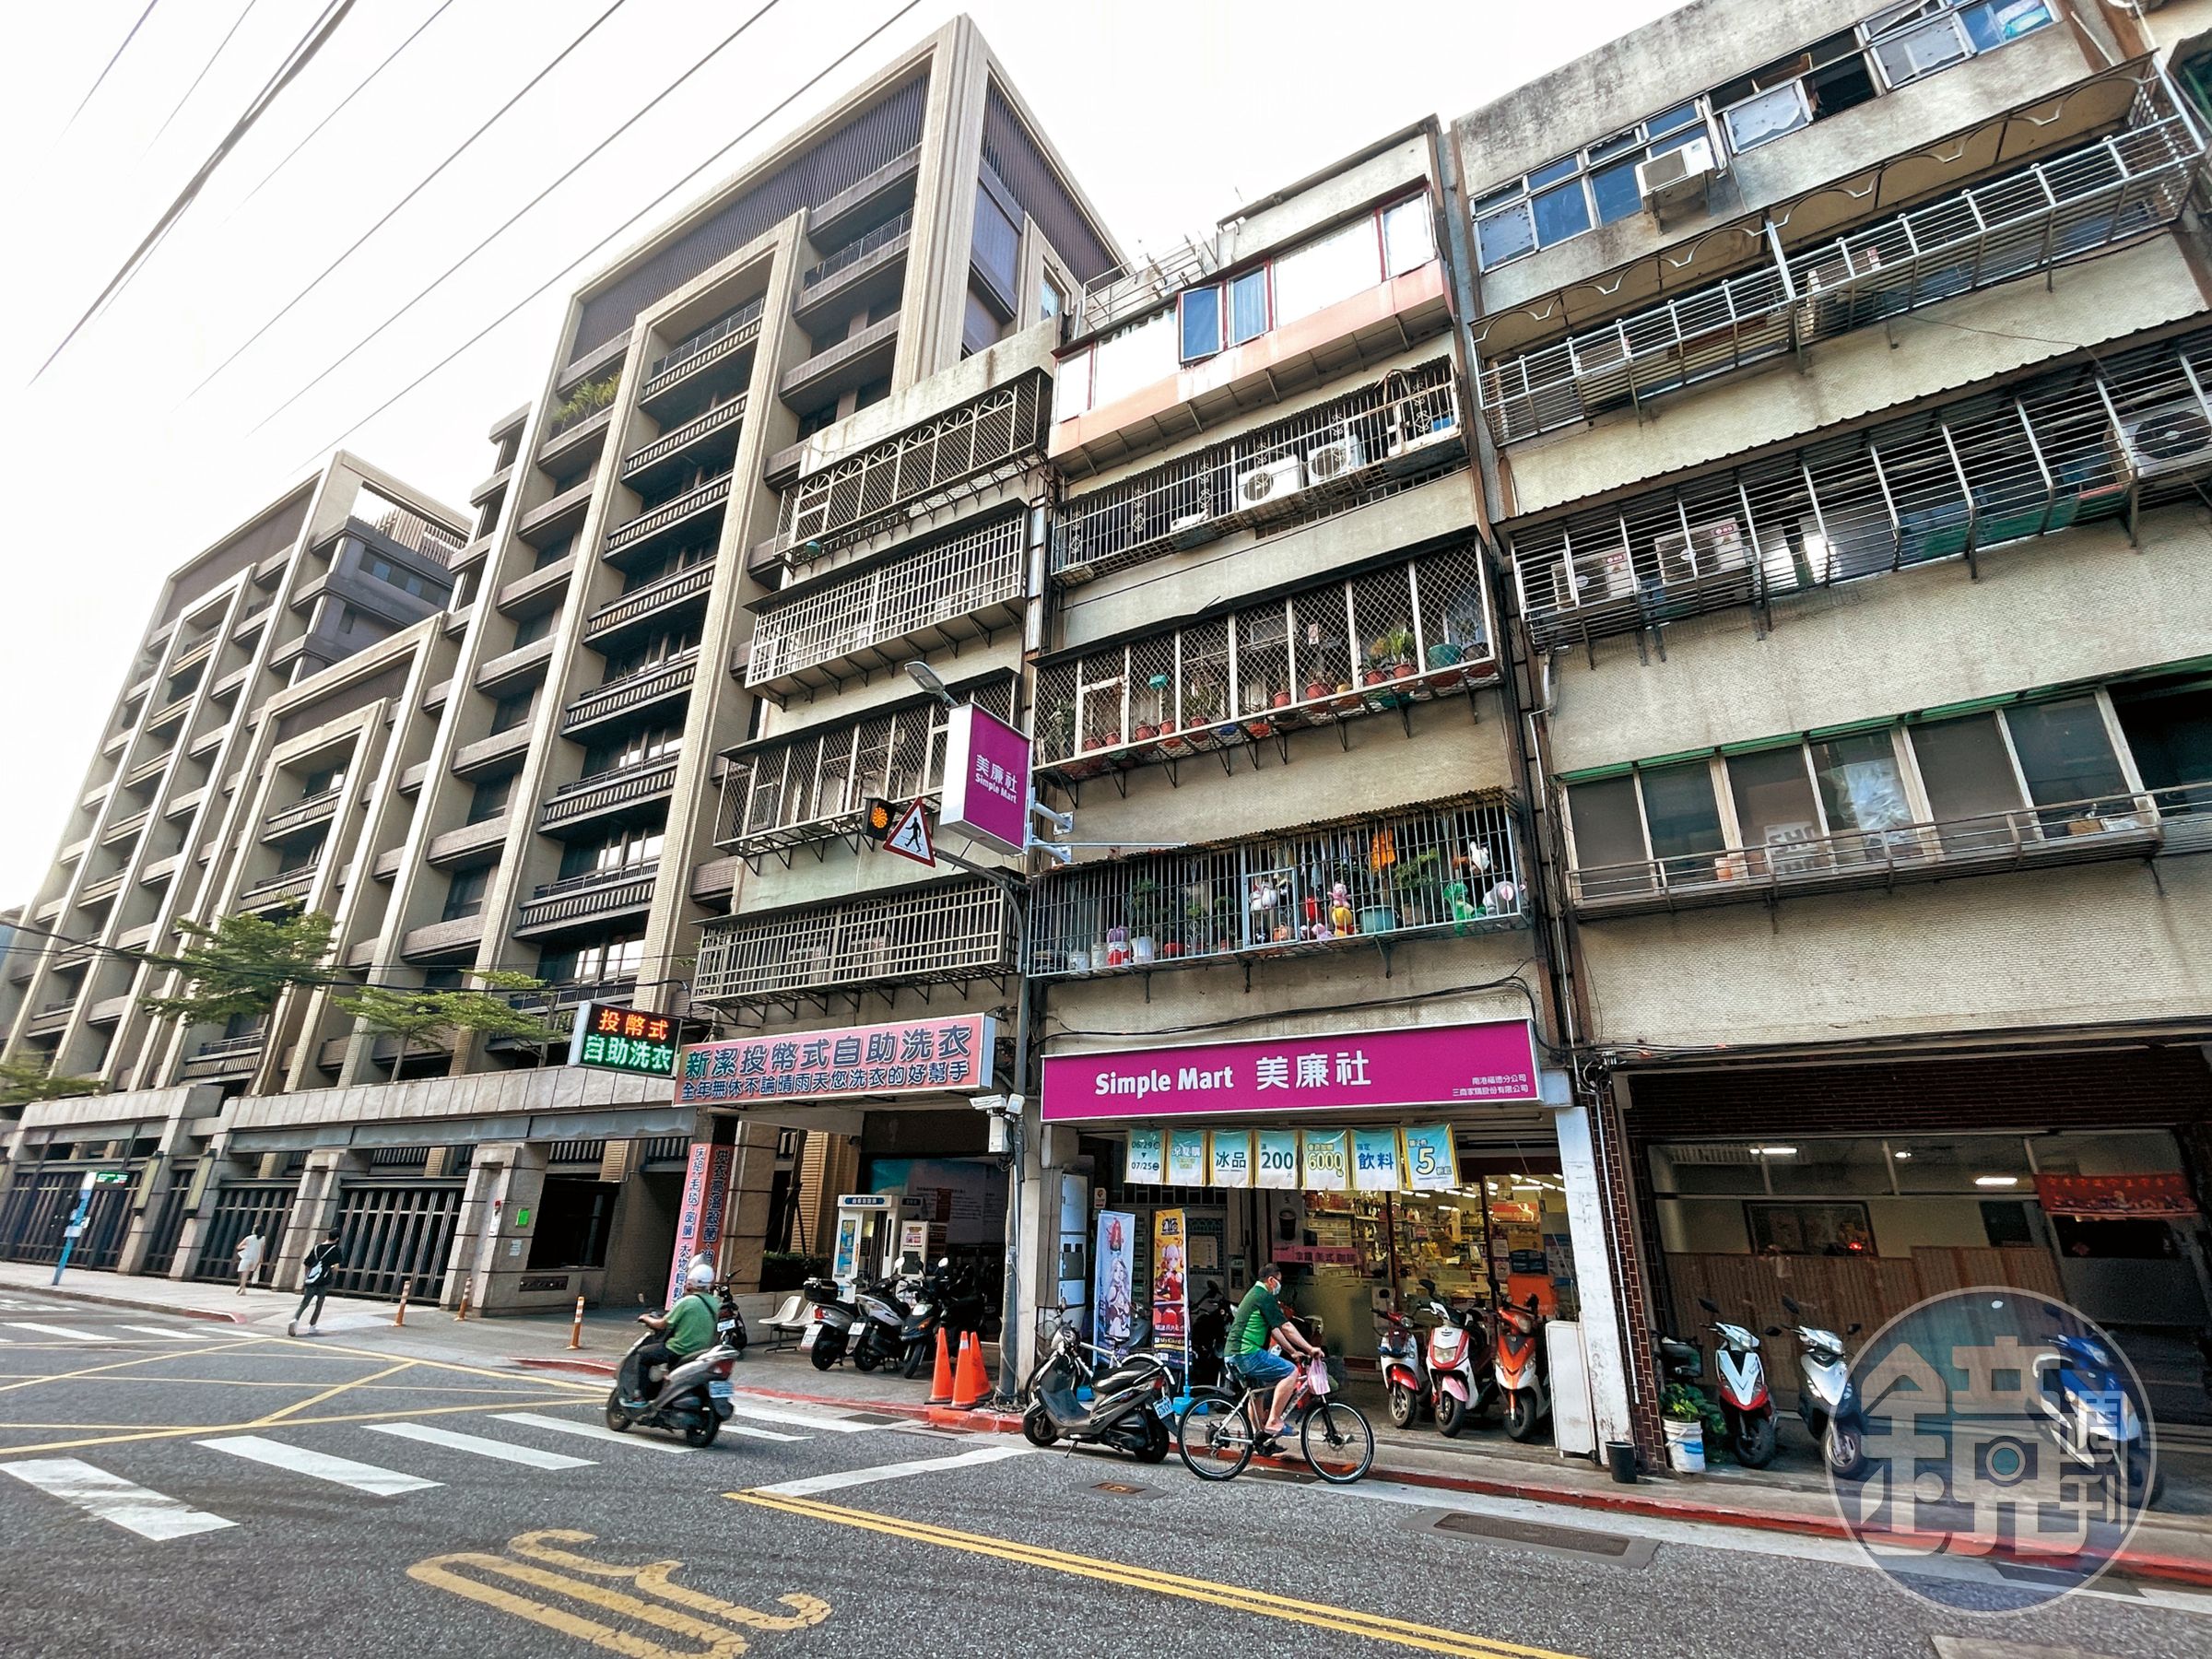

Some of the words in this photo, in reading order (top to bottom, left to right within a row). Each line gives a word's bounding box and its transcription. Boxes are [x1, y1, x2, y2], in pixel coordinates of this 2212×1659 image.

[975, 773, 999, 794] Simple
[1001, 788, 1018, 805] Mart
[976, 754, 1018, 794] 美廉社
[598, 1009, 669, 1041] 投幣式
[583, 1033, 674, 1071] 自助洗衣
[685, 1025, 972, 1079] 新潔投幣式自助洗衣
[681, 1061, 971, 1100] 全年無休不論晴雨天您洗衣的好幫手
[1095, 1069, 1171, 1100] Simple
[1177, 1065, 1234, 1091] Mart
[1255, 1050, 1371, 1090] 美廉社
[1216, 1150, 1246, 1168] 冰品
[1261, 1151, 1294, 1170] 200
[1308, 1151, 1343, 1171] 6000
[1359, 1152, 1394, 1171] 飲料
[1416, 1146, 1436, 1175] 5
